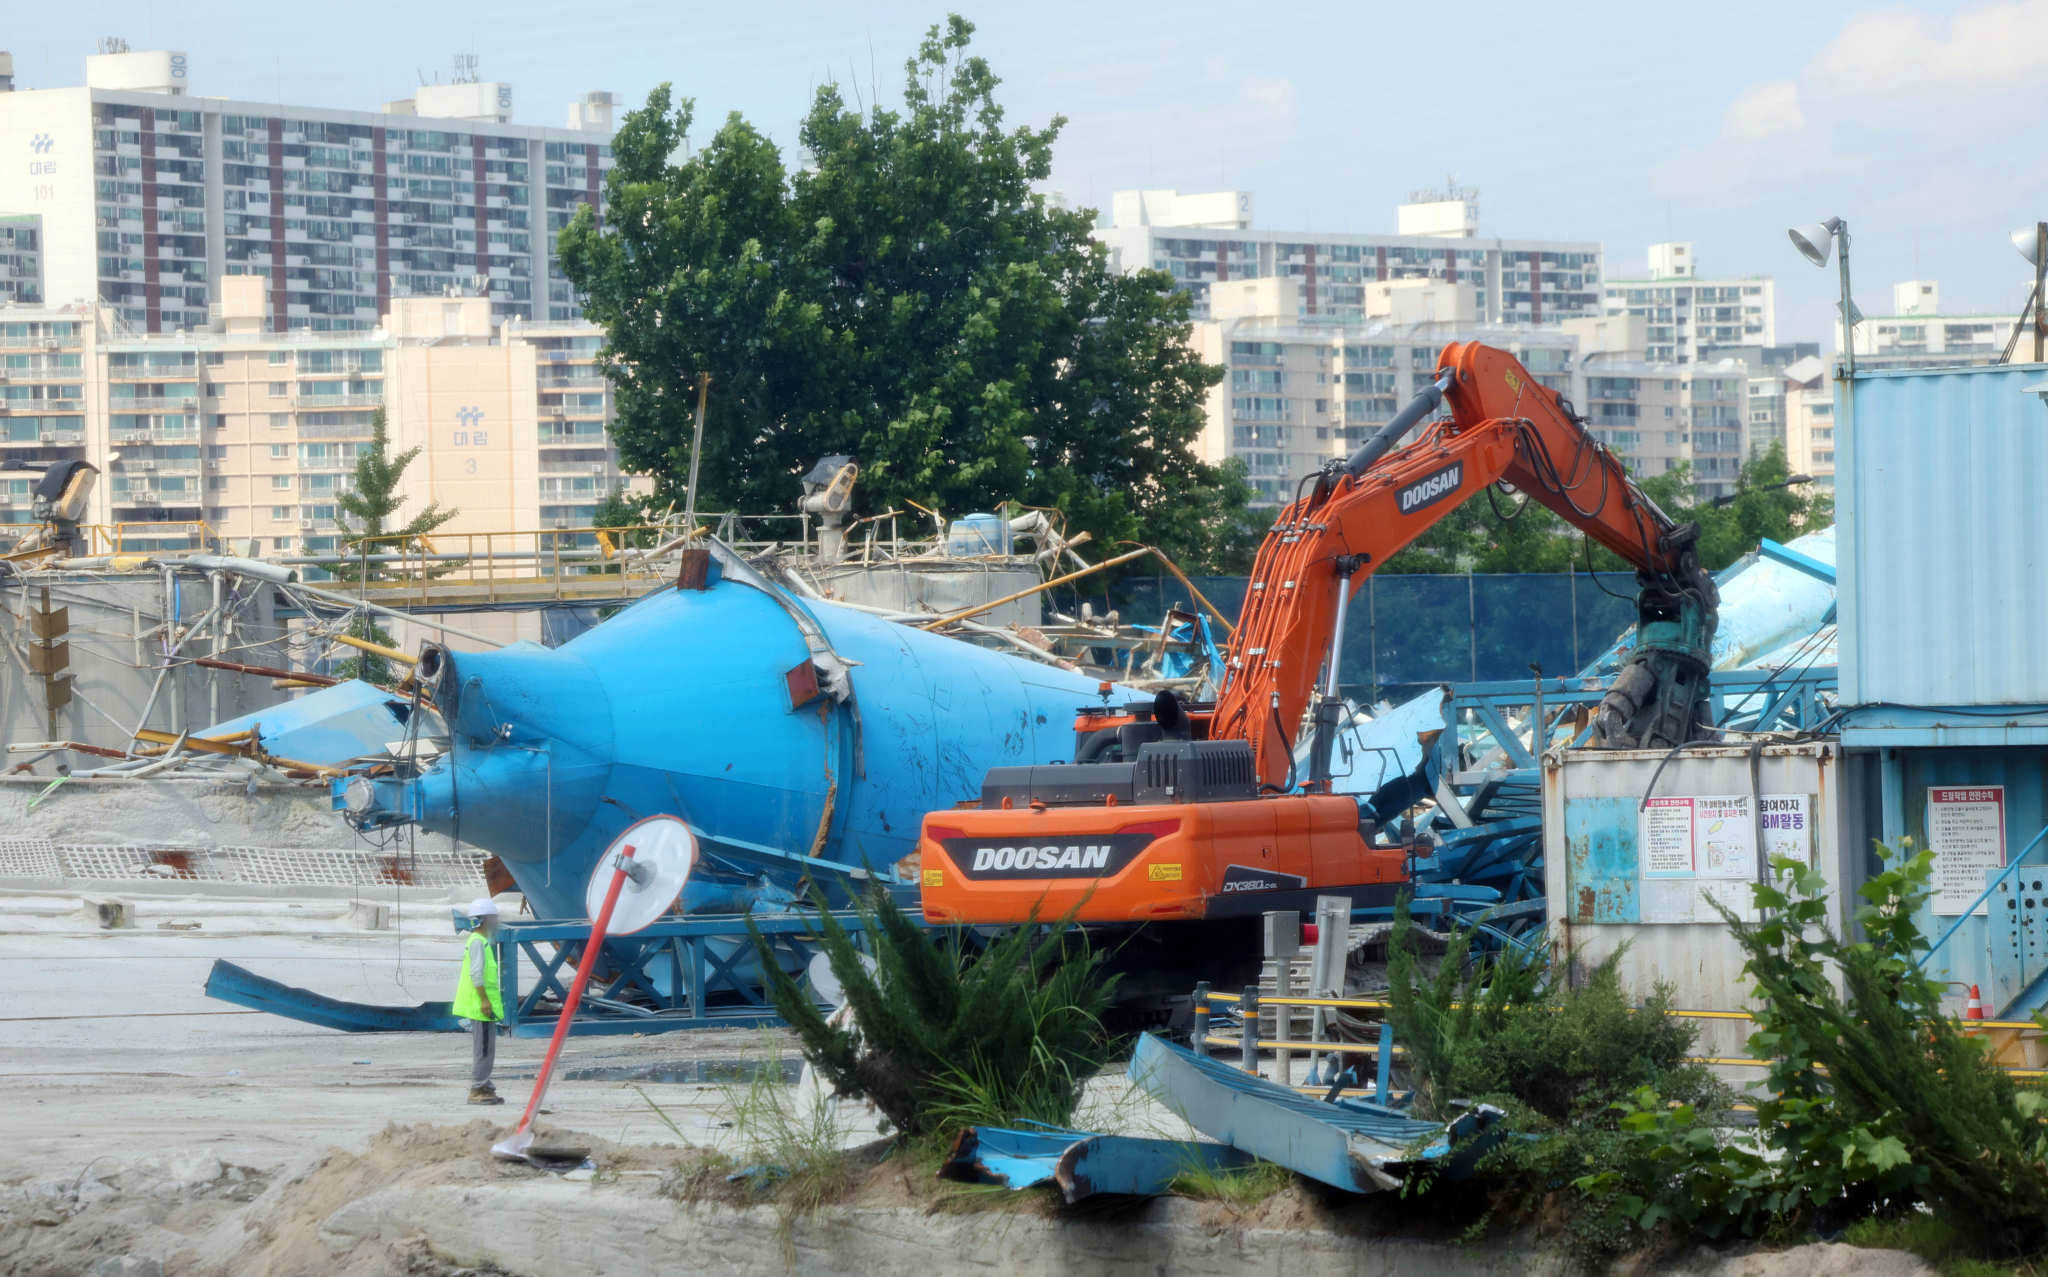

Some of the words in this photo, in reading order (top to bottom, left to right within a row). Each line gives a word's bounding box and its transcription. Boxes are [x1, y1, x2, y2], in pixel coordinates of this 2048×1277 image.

[30, 161, 56, 175] 대림
[33, 184, 54, 200] 101
[1240, 195, 1249, 212] 2
[454, 431, 487, 446] 대림
[466, 458, 477, 474] 3
[1403, 467, 1459, 510] DOOSAN
[1968, 790, 1994, 800] 안전수칙
[1759, 799, 1800, 811] 참여하자
[1762, 813, 1803, 830] BM활동
[973, 846, 1111, 870] DOOSAN
